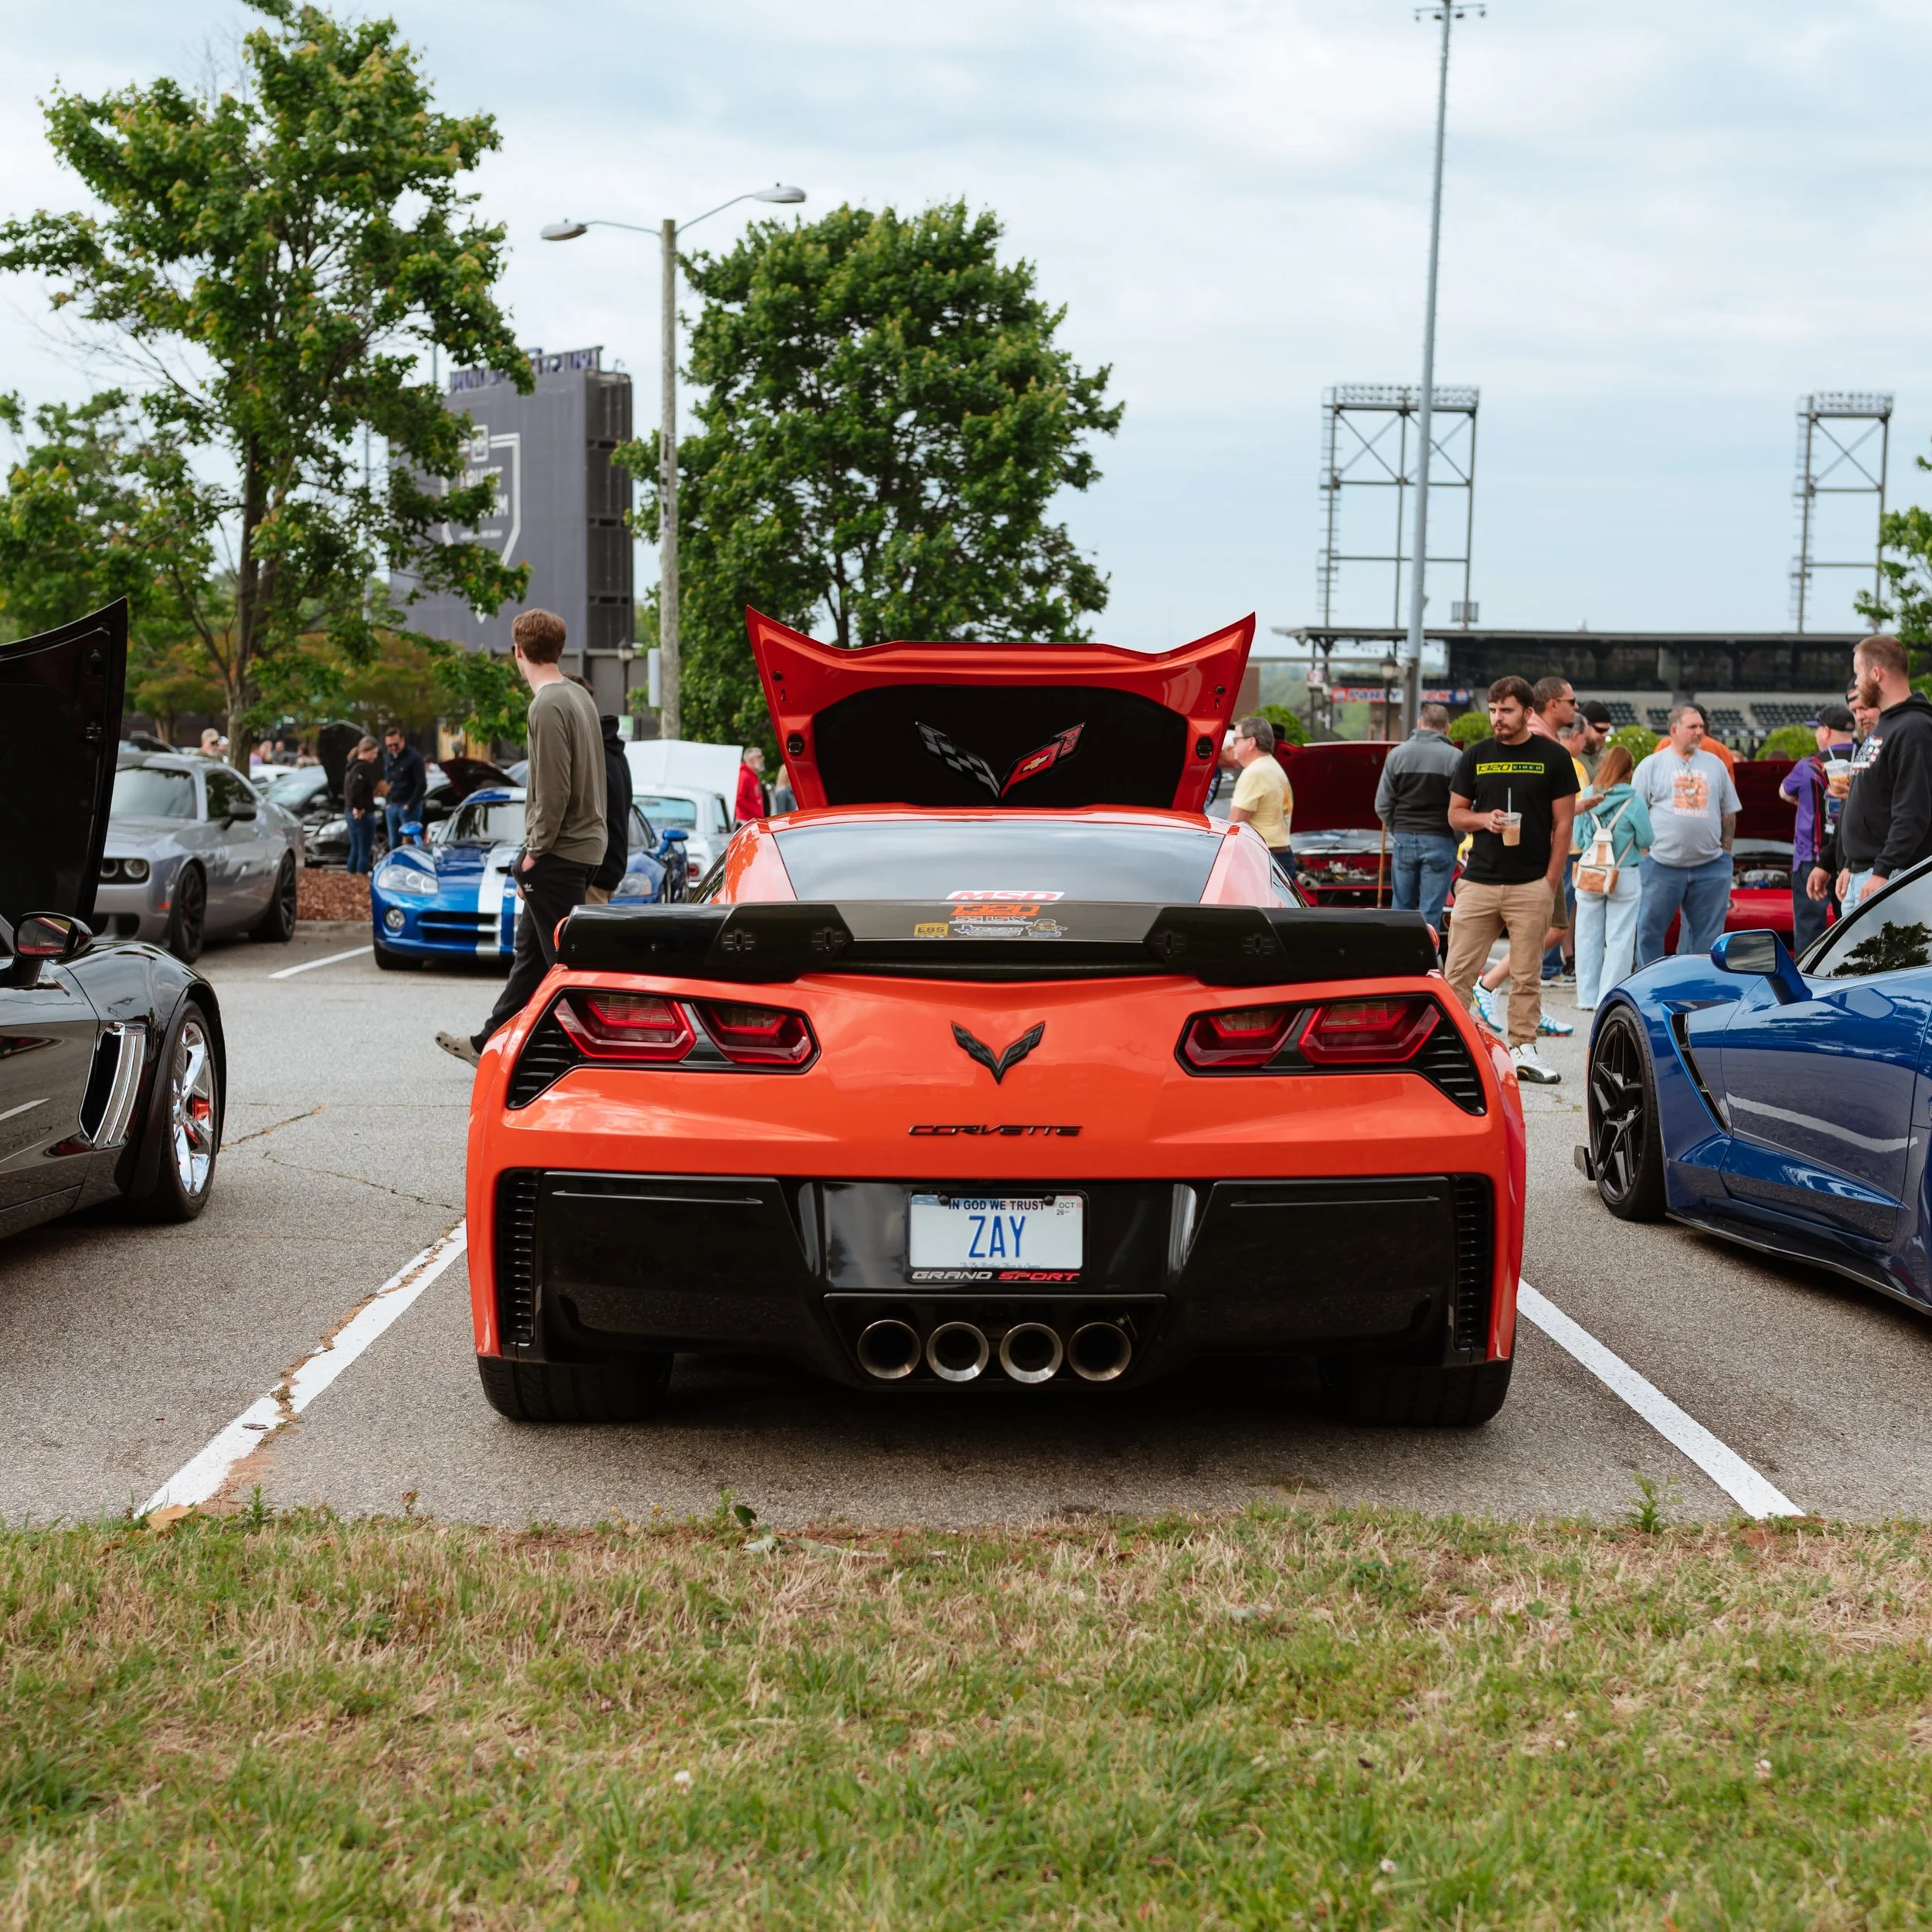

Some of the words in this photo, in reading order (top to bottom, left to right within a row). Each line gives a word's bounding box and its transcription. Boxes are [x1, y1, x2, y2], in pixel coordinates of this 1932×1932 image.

[951, 891, 1058, 901] MSD
[951, 903, 1042, 916] 1320
[908, 1124, 1083, 1135] CORVETTE
[949, 1200, 959, 1209] IN
[964, 1200, 986, 1209] GOD
[990, 1200, 1006, 1209] WE
[1010, 1200, 1044, 1210] TRUST
[968, 1215, 1026, 1258] ZAY
[912, 1270, 992, 1280] GRAND
[998, 1271, 1080, 1281] SPORT
